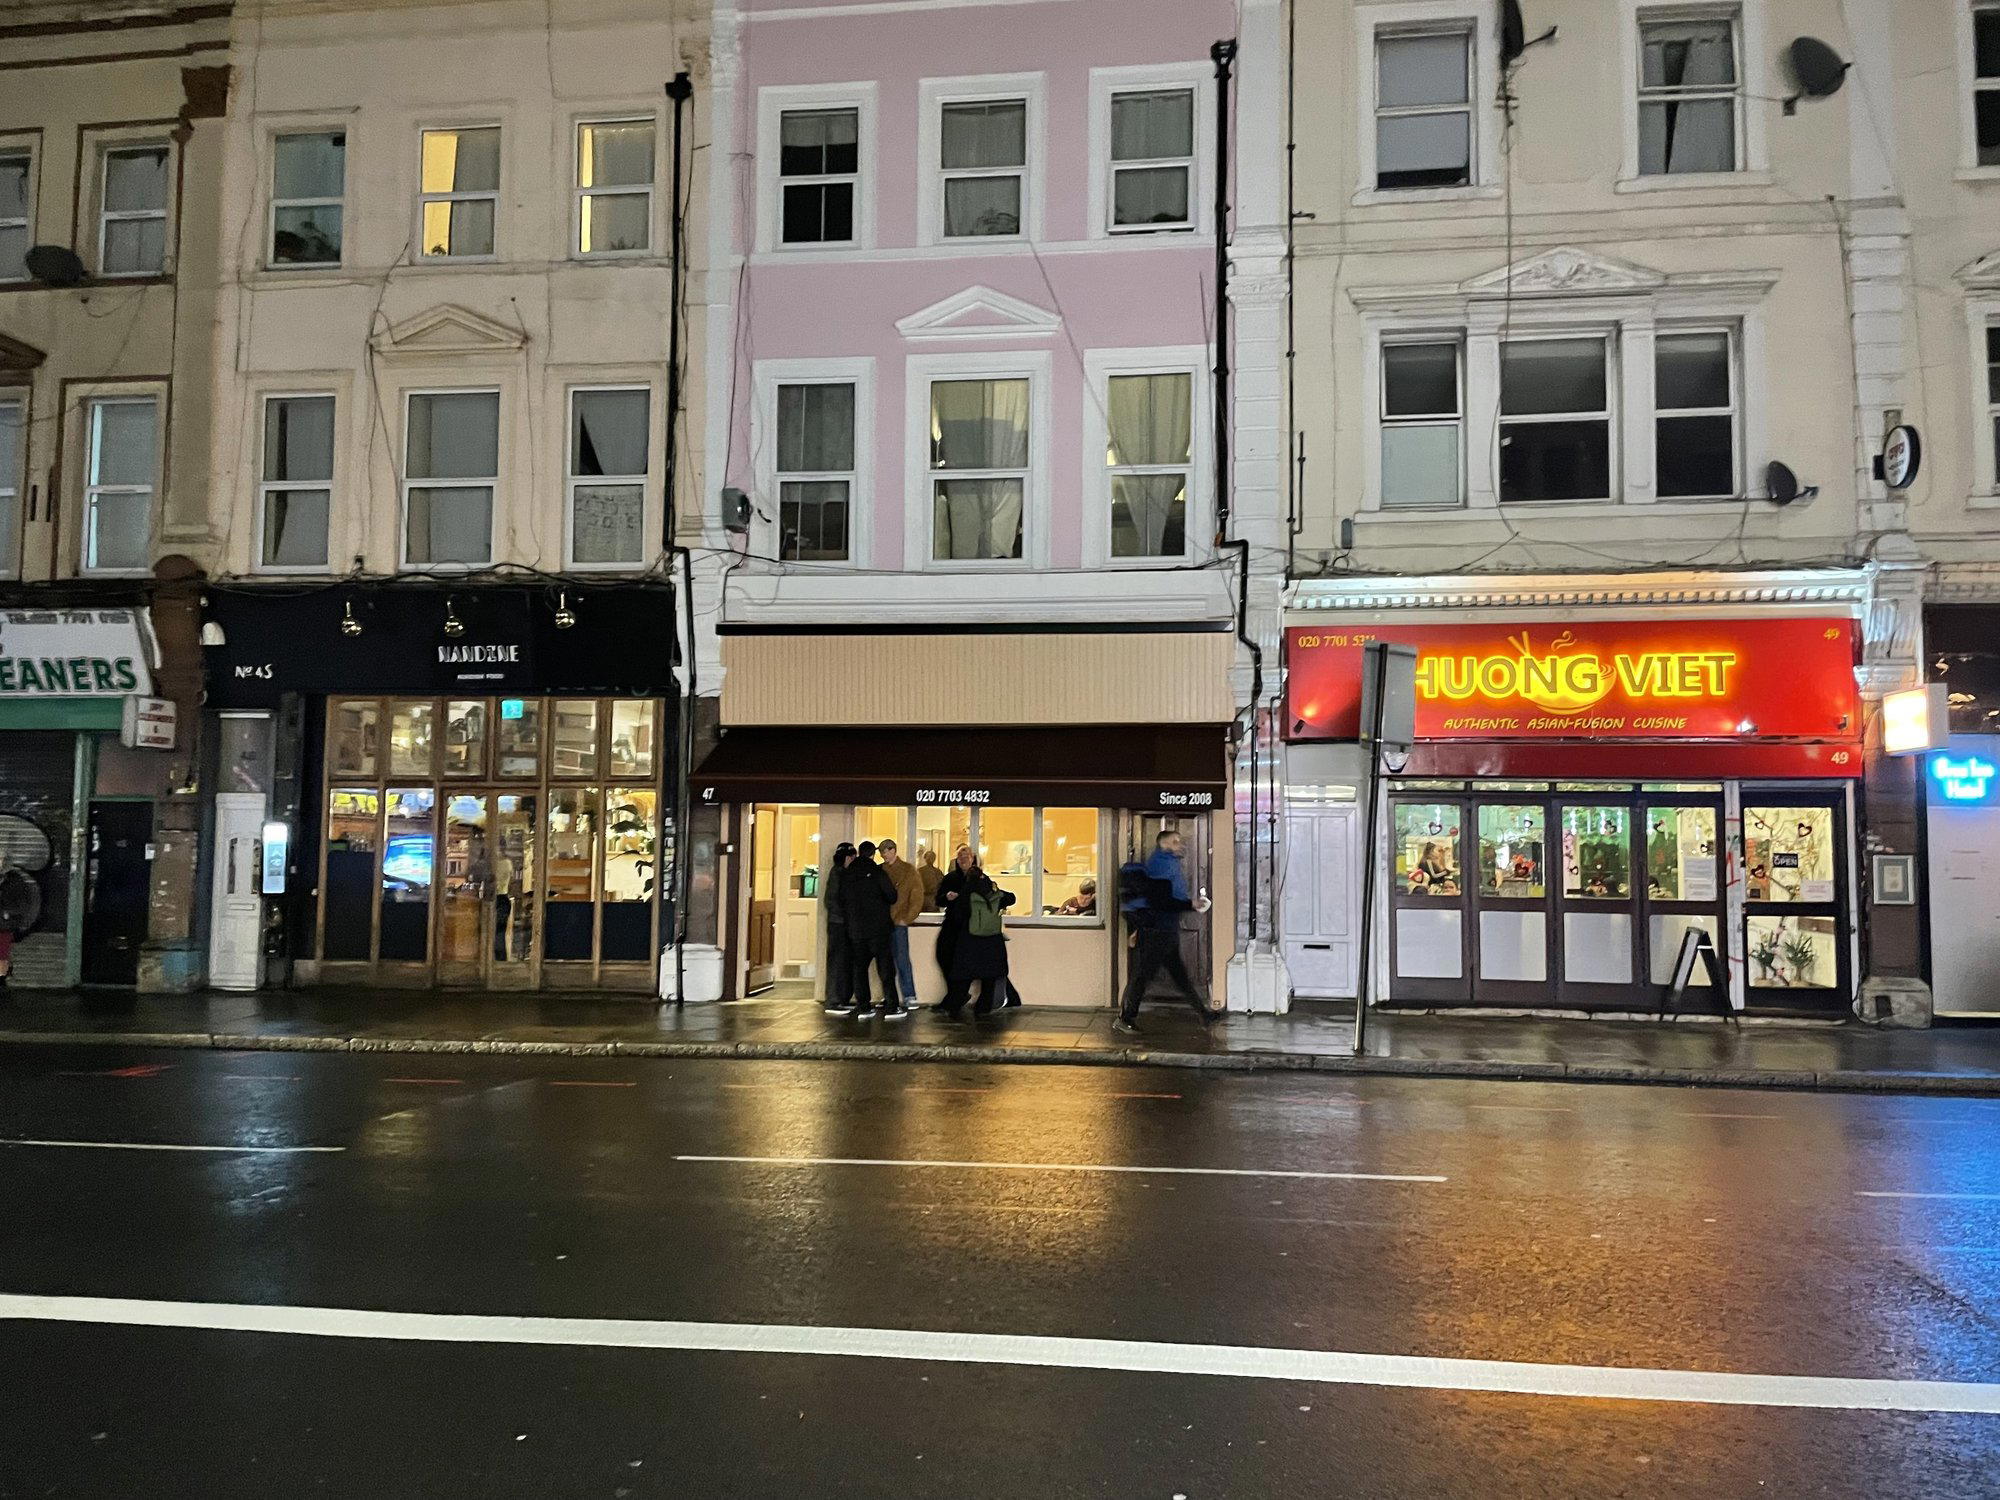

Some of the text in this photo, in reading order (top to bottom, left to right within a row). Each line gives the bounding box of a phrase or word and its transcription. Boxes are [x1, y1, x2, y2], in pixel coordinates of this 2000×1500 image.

[1824, 628, 1840, 640] 49
[1298, 636, 1320, 648] 020
[1323, 635, 1348, 647] 7701
[438, 645, 520, 662] NANDINE
[0, 657, 137, 691] EANERS
[255, 663, 273, 679] 45
[1615, 652, 1736, 697] VIET
[1443, 717, 1688, 730] AUTHENTIC ASIAN-FUSION CUISINE
[1831, 751, 1850, 765] 49
[702, 787, 715, 800] 47
[916, 789, 989, 803] 020 7703 4832
[1159, 792, 1212, 805] Since 2008
